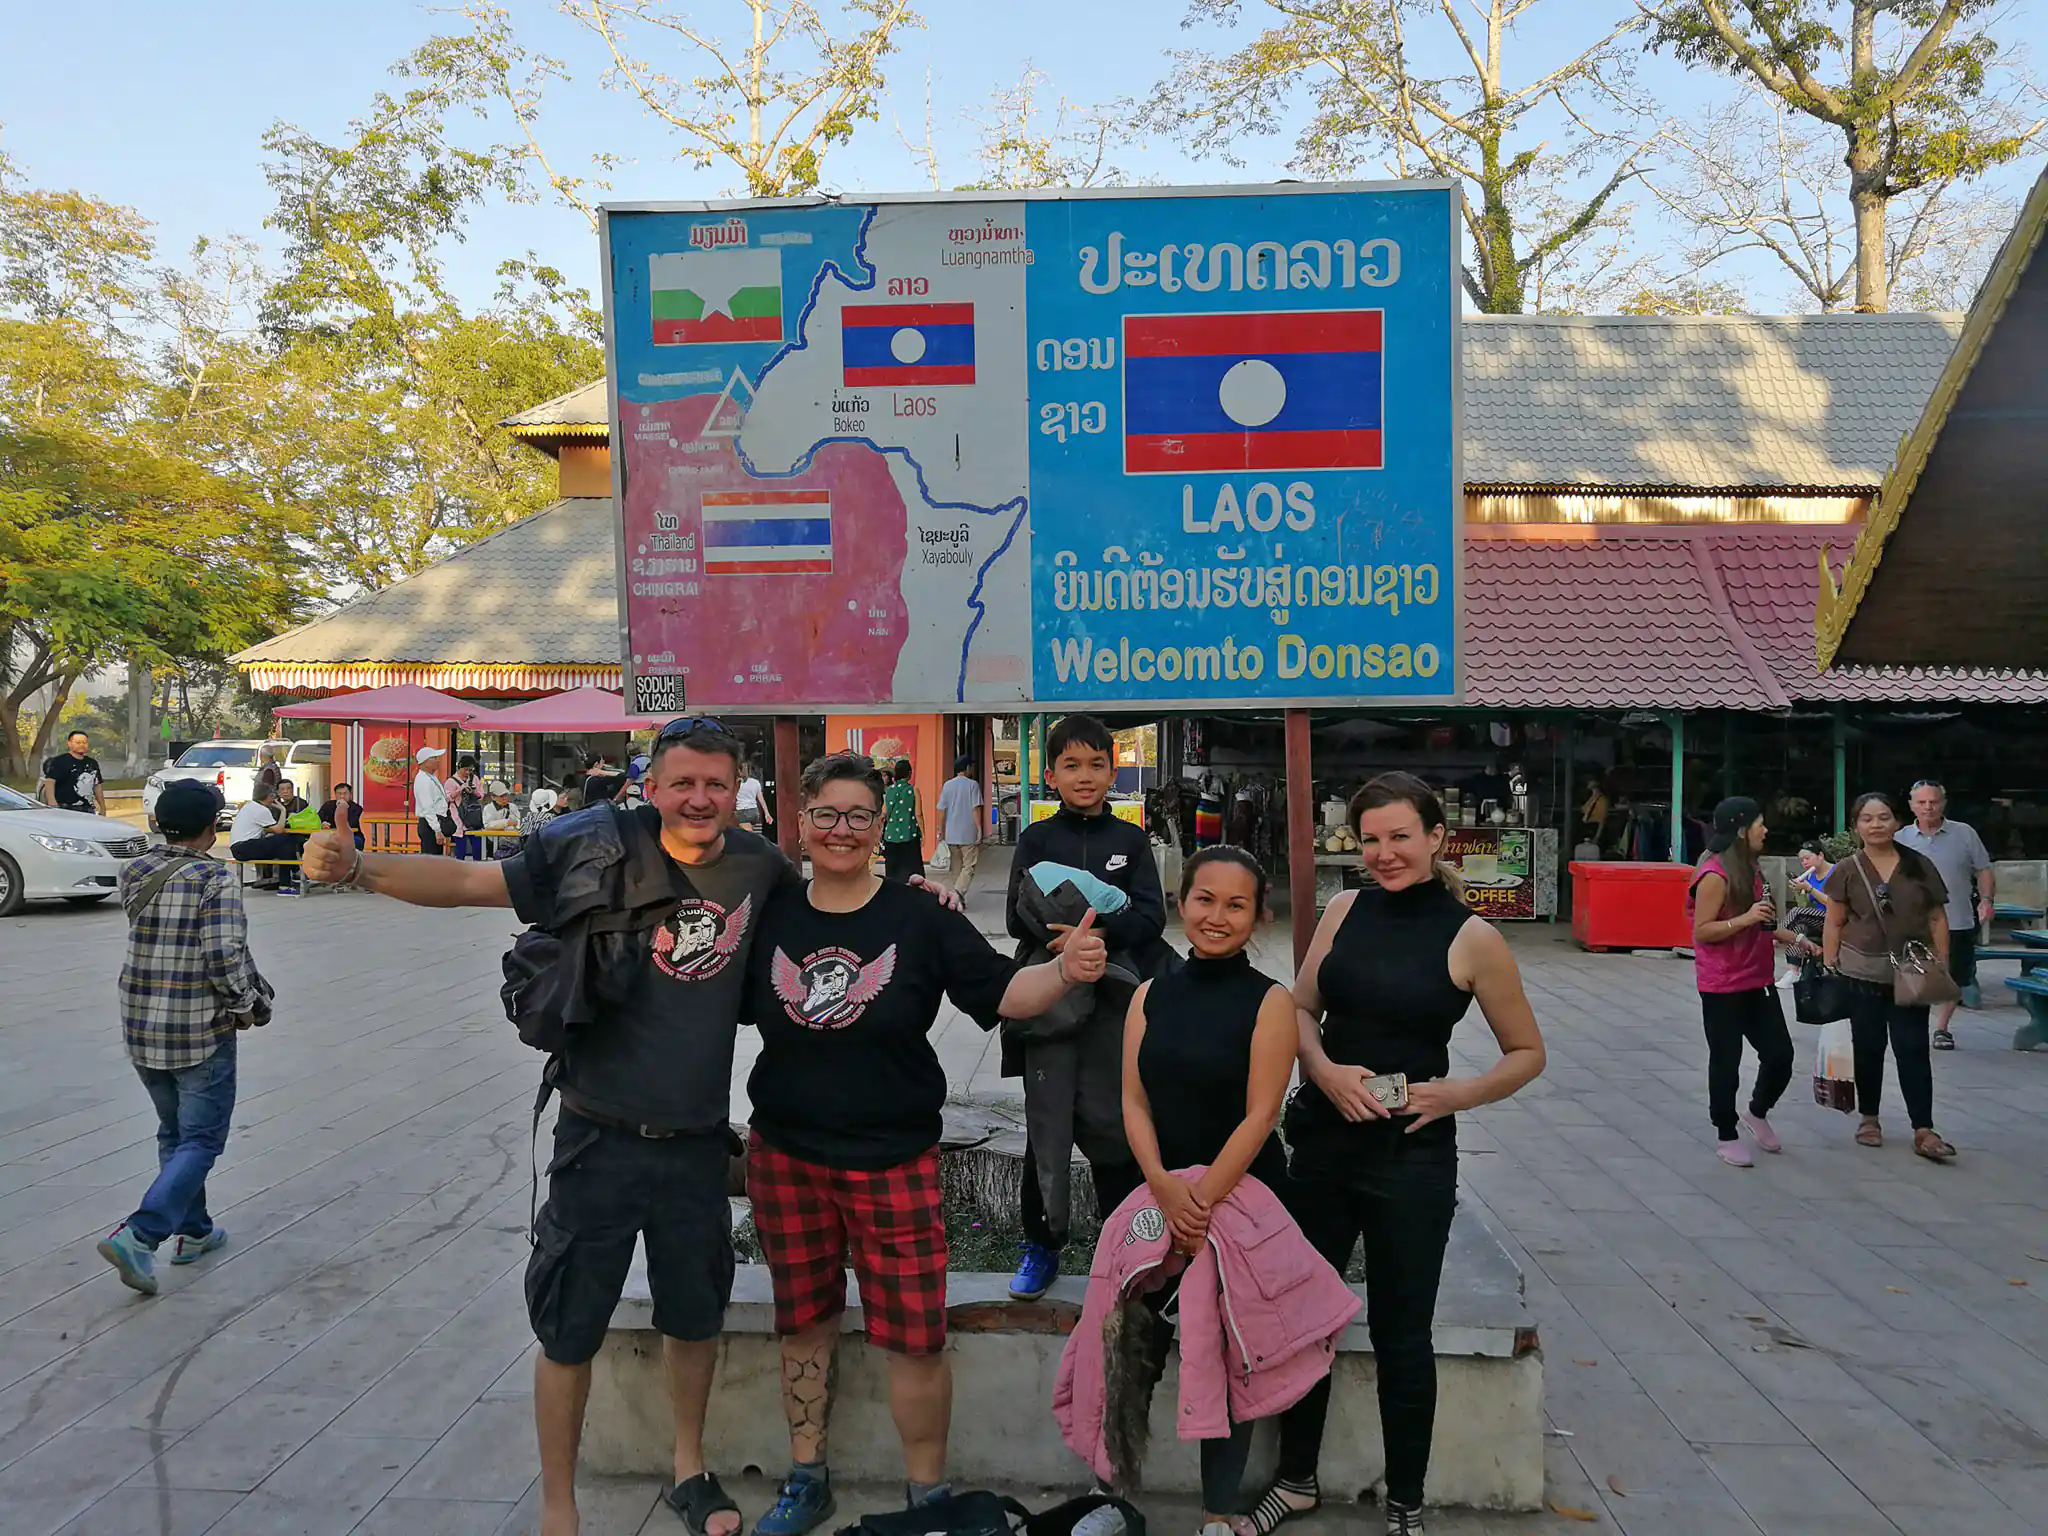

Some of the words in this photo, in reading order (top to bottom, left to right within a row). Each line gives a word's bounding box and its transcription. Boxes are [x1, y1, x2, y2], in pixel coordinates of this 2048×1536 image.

[941, 246, 1034, 269] Luangnamtha
[1078, 231, 1402, 295] ປະເທດລາວ
[887, 276, 929, 296] ລາວ
[1036, 337, 1115, 371] ດອນ
[893, 392, 937, 417] Laos
[834, 416, 865, 432] Bokeo
[1040, 401, 1107, 443] ຊາວ
[1182, 481, 1316, 533] LAOS
[650, 533, 695, 551] Thailand
[922, 549, 973, 567] Xayabouly
[868, 628, 889, 636] NAN
[1051, 636, 1265, 684] Welcomto
[1276, 634, 1440, 680] Donsao
[637, 676, 675, 693] SODUH
[638, 694, 676, 711] YU246
[1465, 889, 1517, 903] OFFEE
